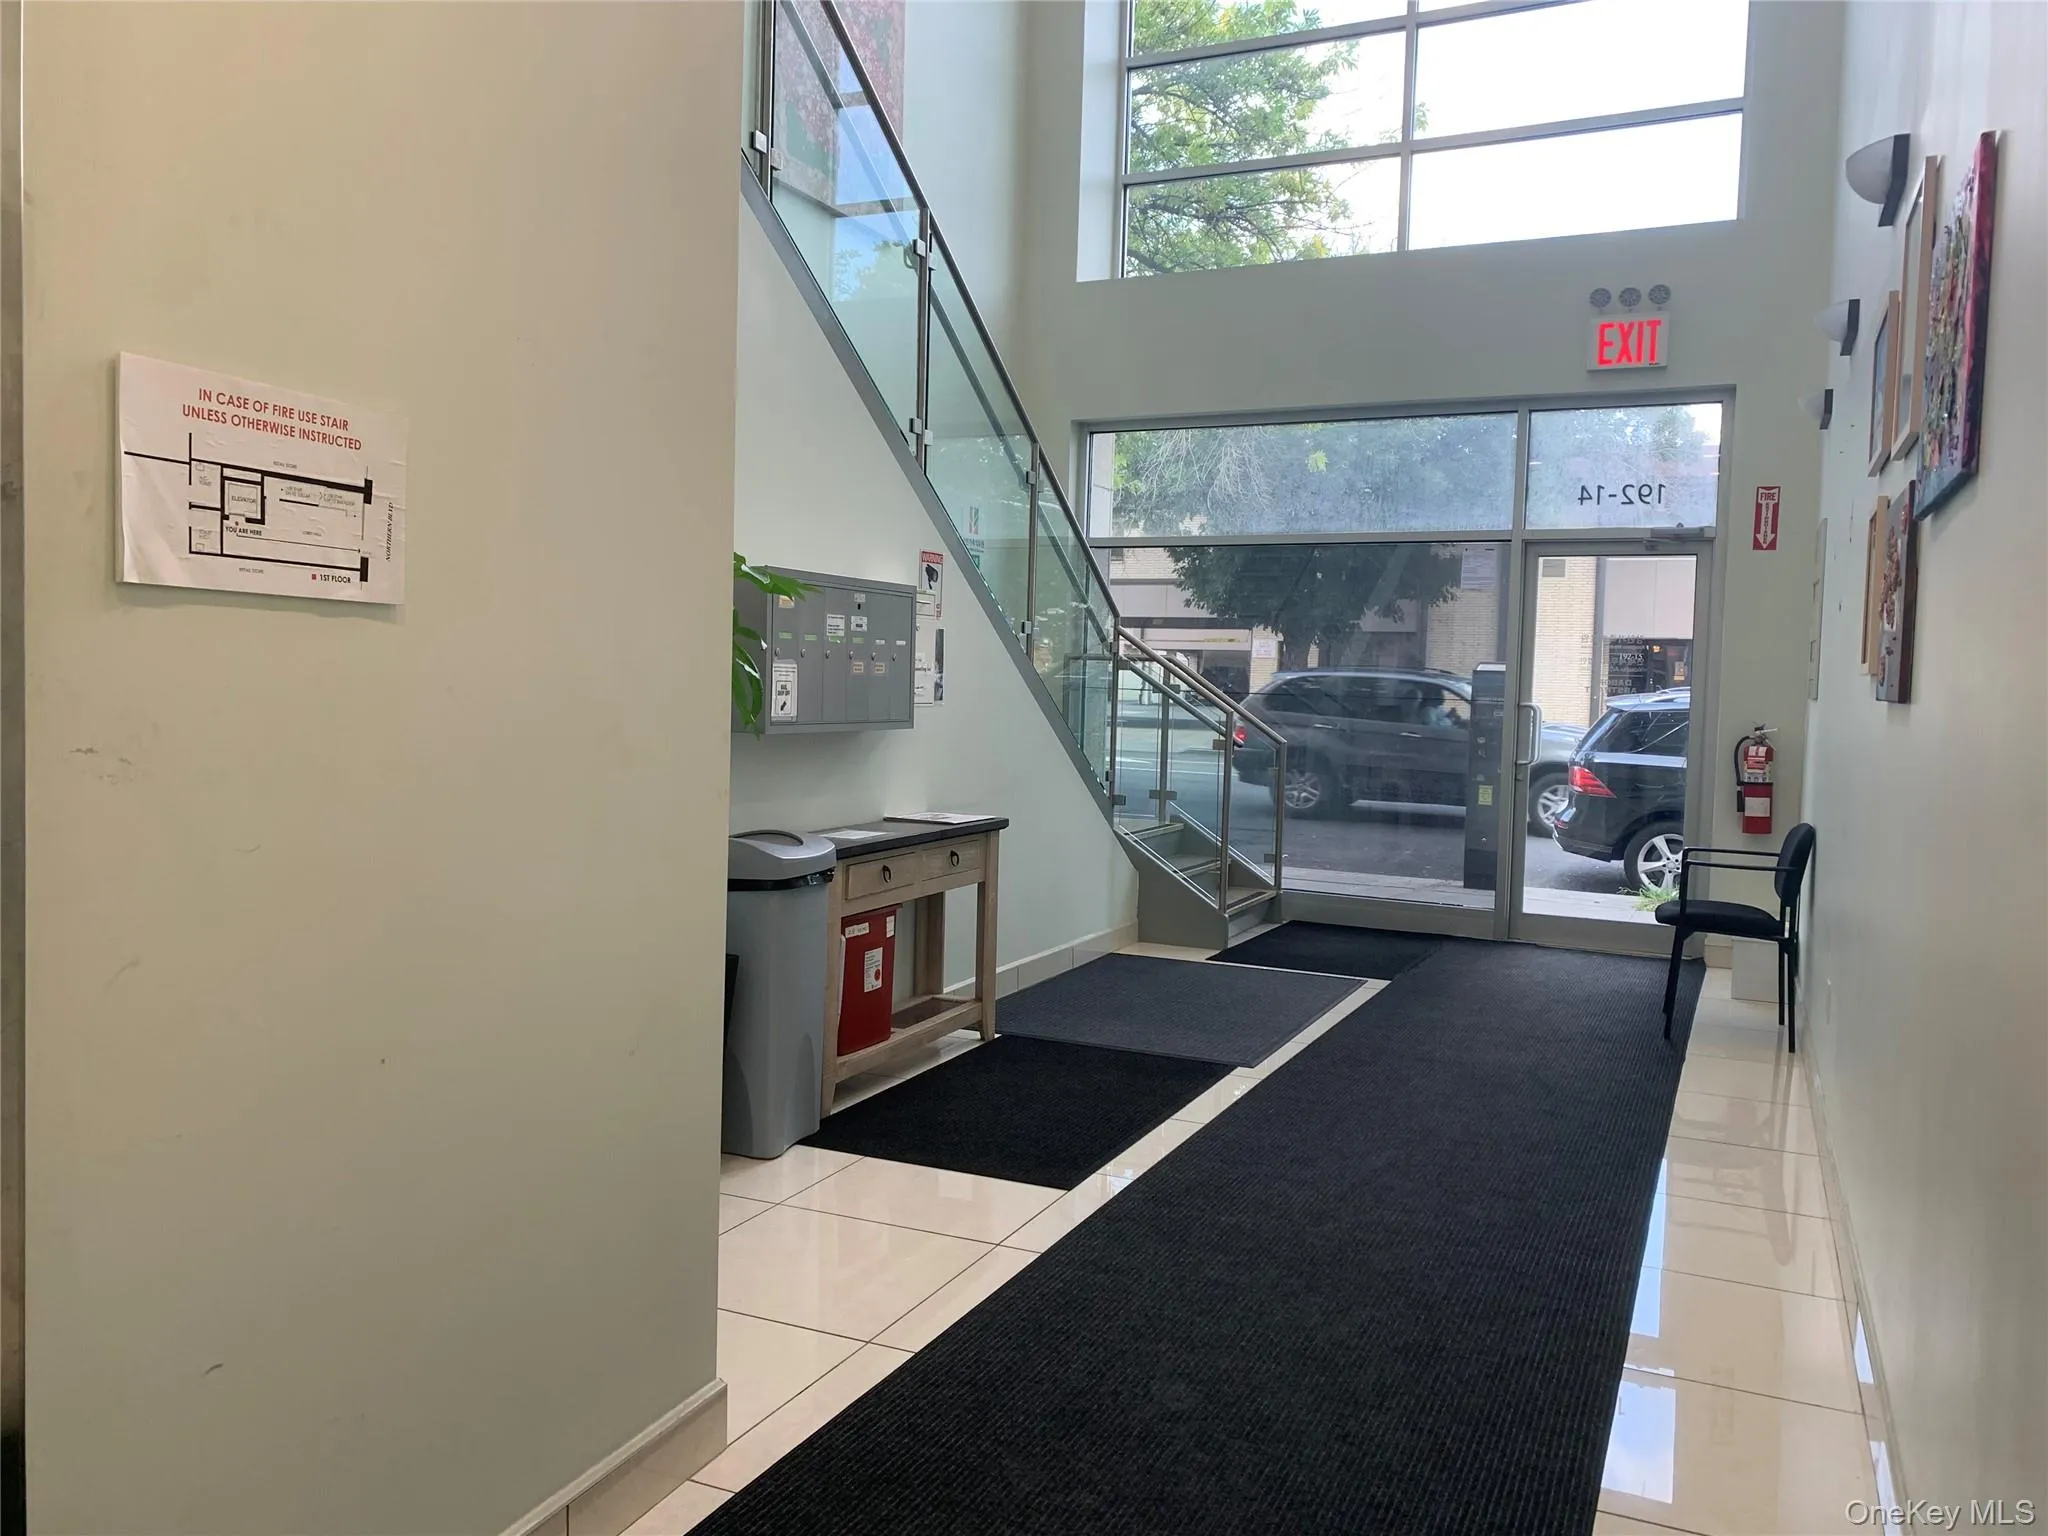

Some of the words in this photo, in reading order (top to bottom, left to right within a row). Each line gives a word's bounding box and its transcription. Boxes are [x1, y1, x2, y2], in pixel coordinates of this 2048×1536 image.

[1598, 320, 1662, 365] EXIT
[199, 387, 213, 403] IN
[216, 391, 249, 411] CASE
[252, 399, 270, 414] OF
[272, 404, 296, 420] FIRE
[298, 410, 318, 426] USE
[320, 415, 349, 432] STAIR
[182, 403, 228, 424] UNLESS
[230, 414, 296, 438] OTHERWISE
[298, 427, 362, 451] INSTRUCTED
[231, 495, 257, 504] ELEVATOR
[1760, 491, 1776, 501] FIRE
[225, 526, 237, 534] YOU
[238, 527, 249, 535] ARE
[249, 529, 262, 537] HERE
[320, 574, 331, 583] 1ST
[331, 574, 352, 584] FLOOR
